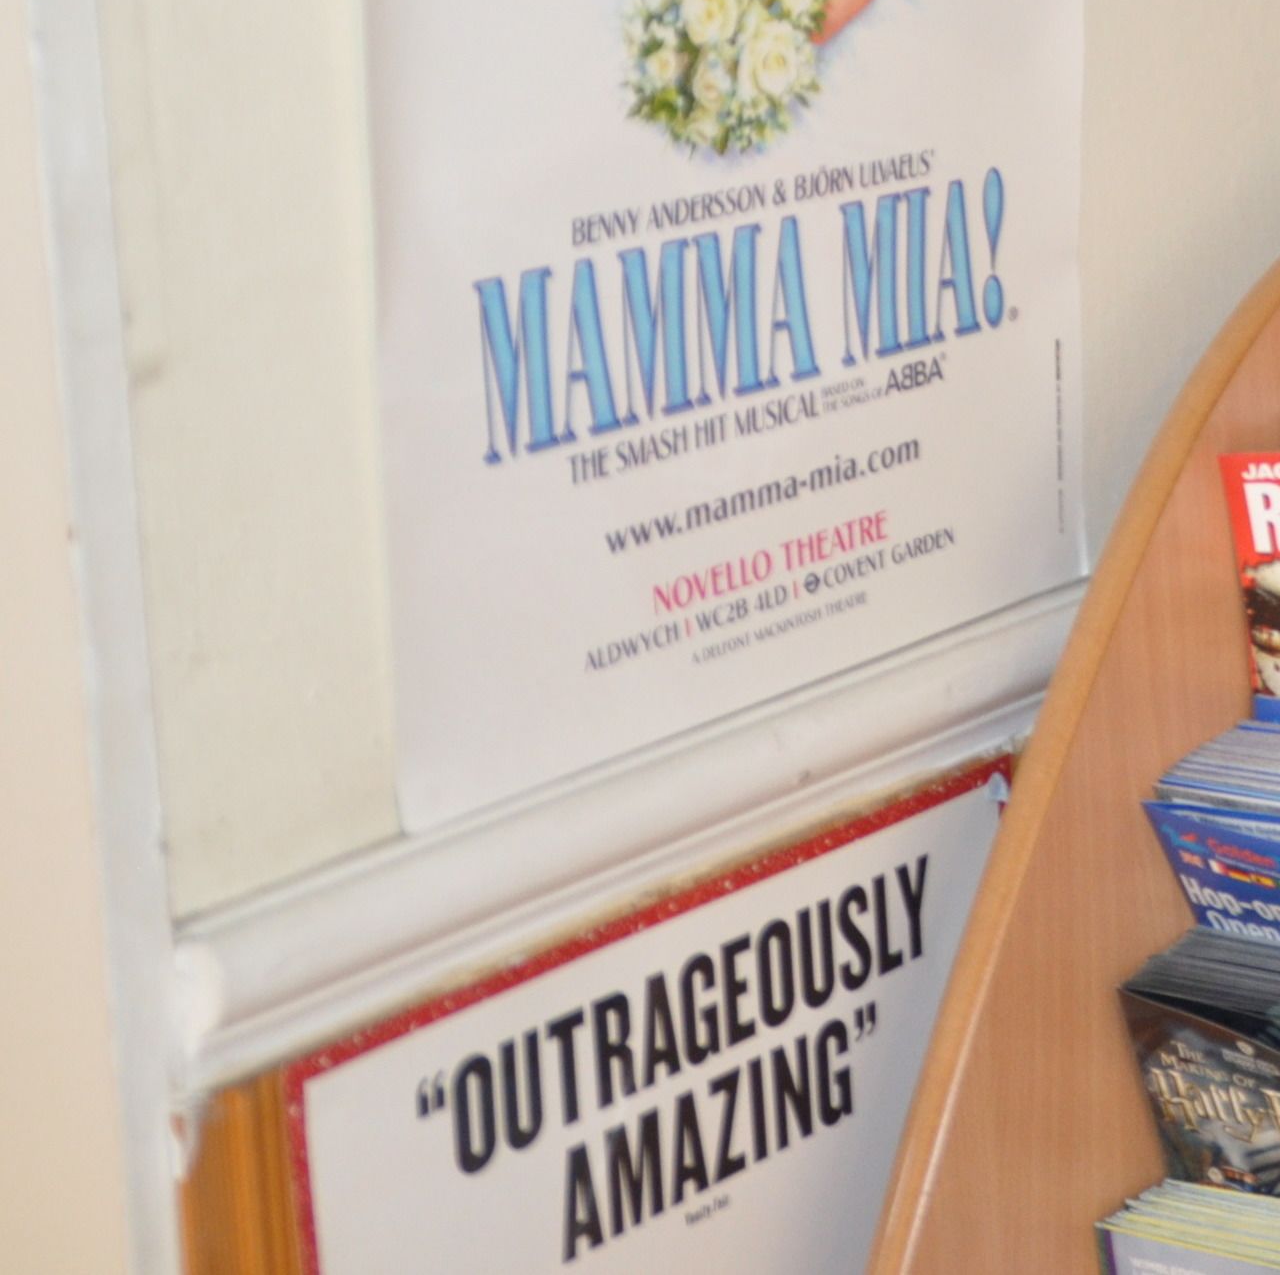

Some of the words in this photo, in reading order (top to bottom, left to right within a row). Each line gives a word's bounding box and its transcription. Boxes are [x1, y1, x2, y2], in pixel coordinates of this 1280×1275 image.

[571, 209, 641, 247] BENNY
[646, 185, 766, 232] ANDERSSON
[774, 180, 787, 208] &
[794, 163, 855, 202] BJÖRN
[472, 215, 822, 466] MAMMA
[839, 166, 1005, 367] MIA!
[885, 357, 943, 396] ABBA
[568, 450, 610, 486] THE
[615, 427, 689, 476] SMASH
[694, 414, 729, 453] HIT
[733, 391, 820, 440] MUSICAL
[606, 435, 921, 555] www.mamma-mia.com
[585, 621, 680, 673] ALDWYCH
[695, 597, 749, 634] WC2B
[754, 585, 789, 615] 4LD
[823, 549, 887, 589] COVENT
[891, 527, 956, 565] GARDEN
[652, 549, 773, 616] NOVELLO
[779, 509, 890, 573] THEATRE
[1149, 1068, 1266, 1143] Harry
